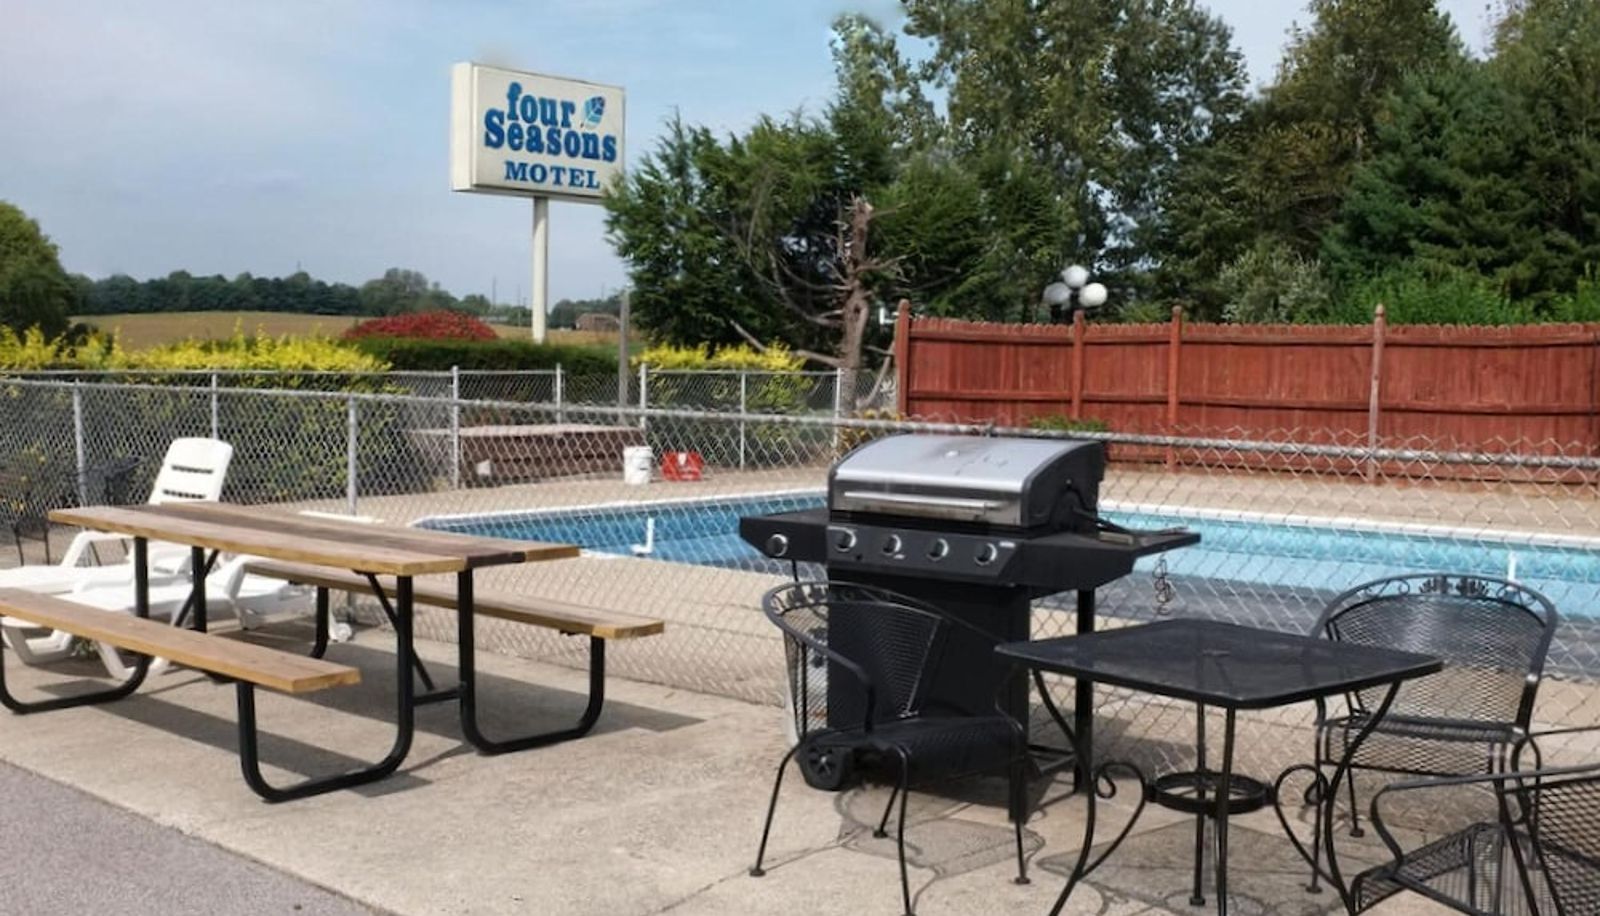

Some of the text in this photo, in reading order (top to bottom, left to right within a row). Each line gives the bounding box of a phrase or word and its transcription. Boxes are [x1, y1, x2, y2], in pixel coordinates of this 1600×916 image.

[507, 82, 575, 128] four
[484, 108, 617, 163] Seasons
[505, 160, 600, 189] MOTEL
